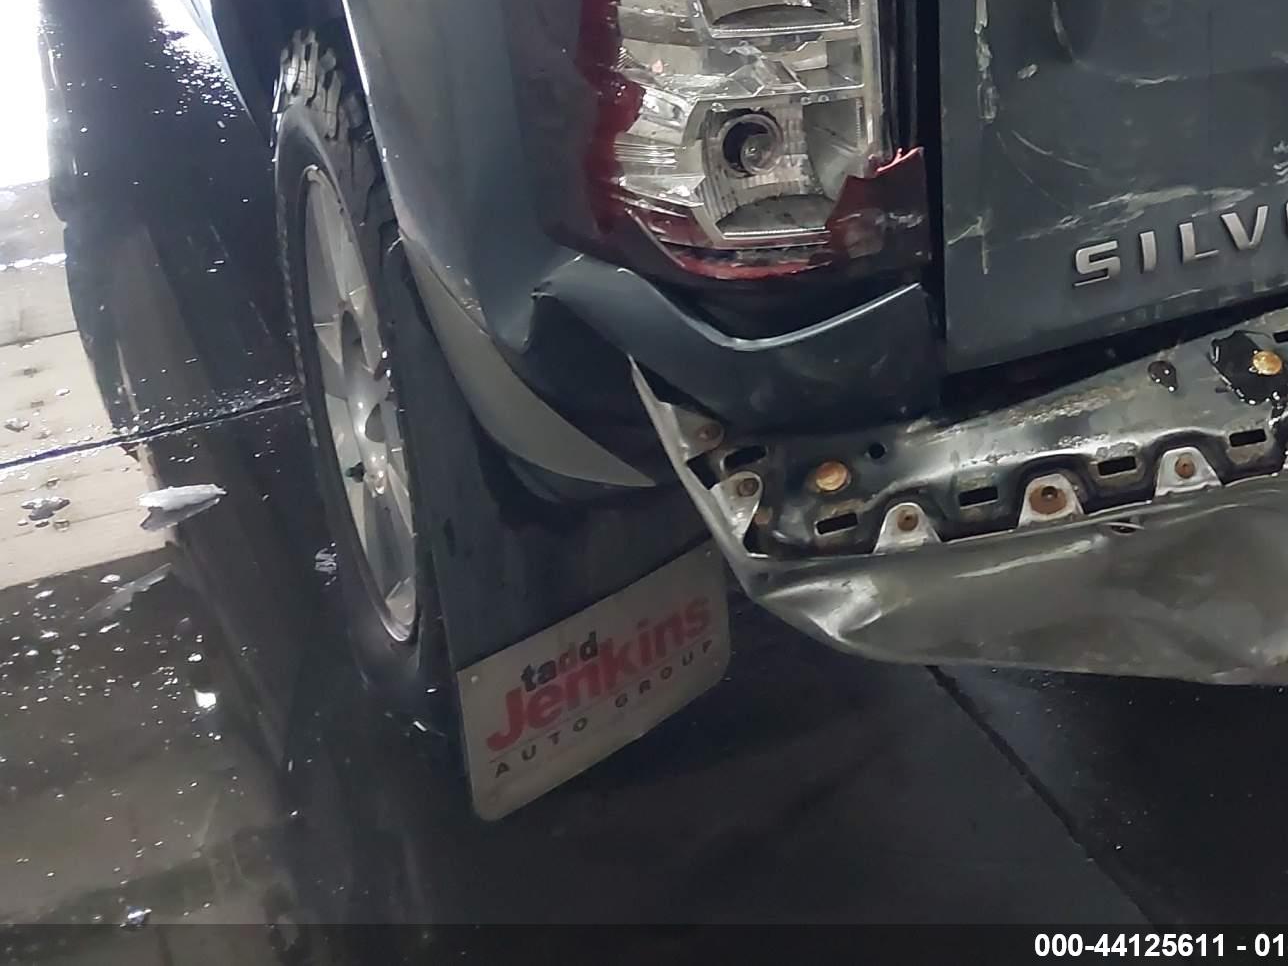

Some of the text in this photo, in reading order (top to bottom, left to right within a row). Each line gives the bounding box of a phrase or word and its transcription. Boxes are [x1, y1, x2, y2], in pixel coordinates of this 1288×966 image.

[486, 596, 711, 752] Jenkins
[495, 639, 712, 778] AUTO GROUP
[521, 631, 598, 692] tadd
